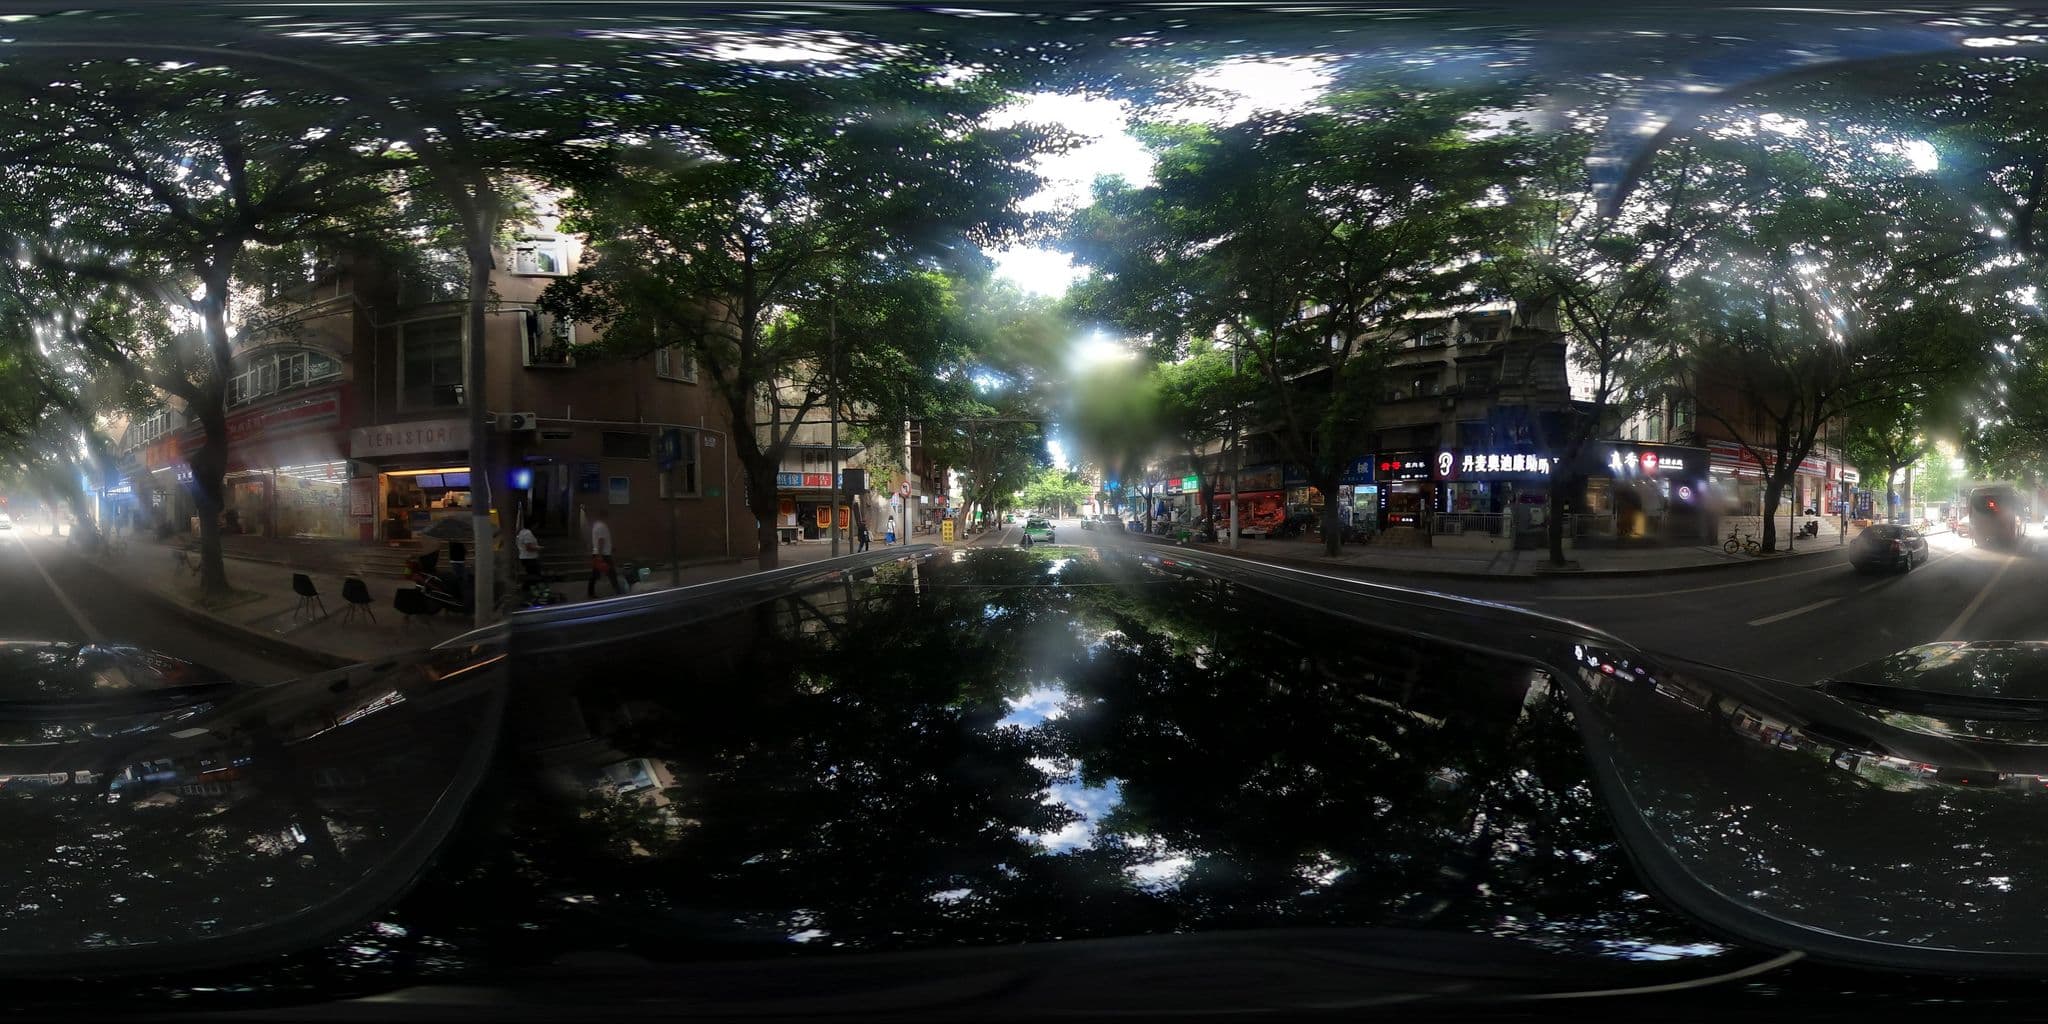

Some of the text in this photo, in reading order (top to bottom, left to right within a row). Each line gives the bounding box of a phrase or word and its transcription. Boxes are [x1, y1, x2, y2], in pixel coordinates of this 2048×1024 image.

[1462, 454, 1560, 475] 丹麦奥迪康助听
[805, 474, 830, 486] 广告
